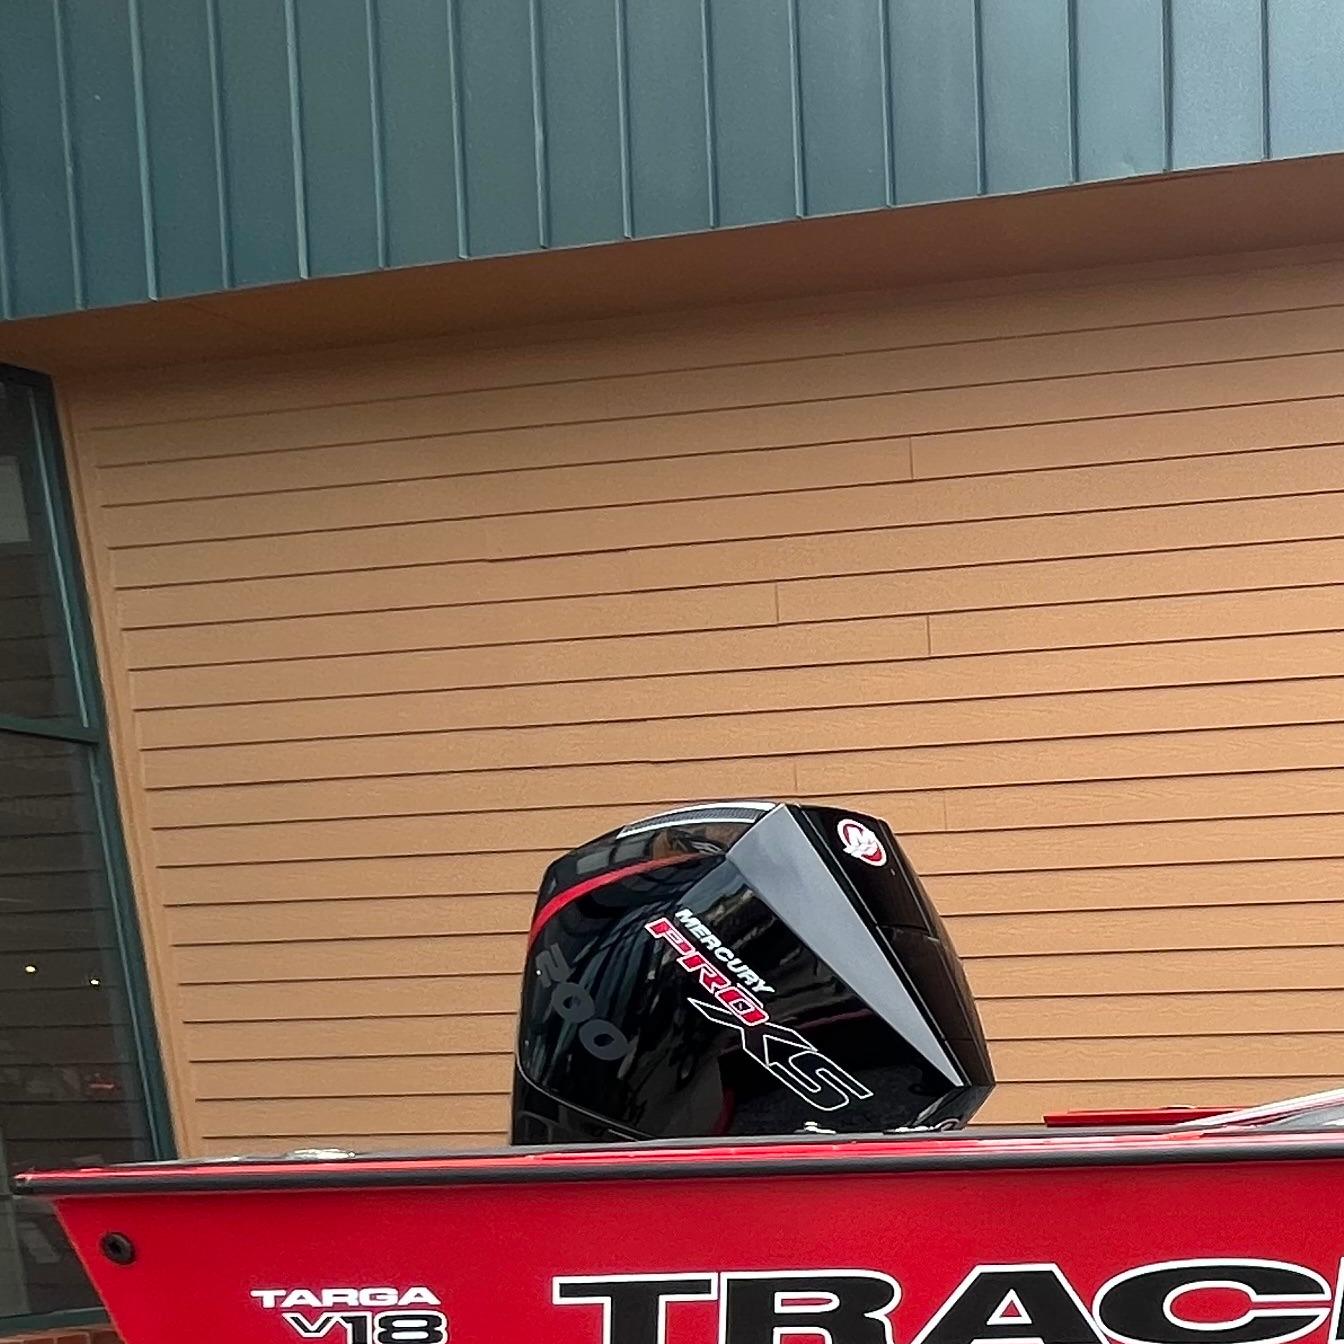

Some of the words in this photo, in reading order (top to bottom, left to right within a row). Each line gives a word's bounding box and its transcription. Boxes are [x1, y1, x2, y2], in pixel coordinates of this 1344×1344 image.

[535, 942, 629, 1061] 200
[644, 916, 770, 1027] PRO
[674, 908, 776, 993] MERCURY
[687, 996, 874, 1111] XS
[250, 1286, 441, 1309] TARGA
